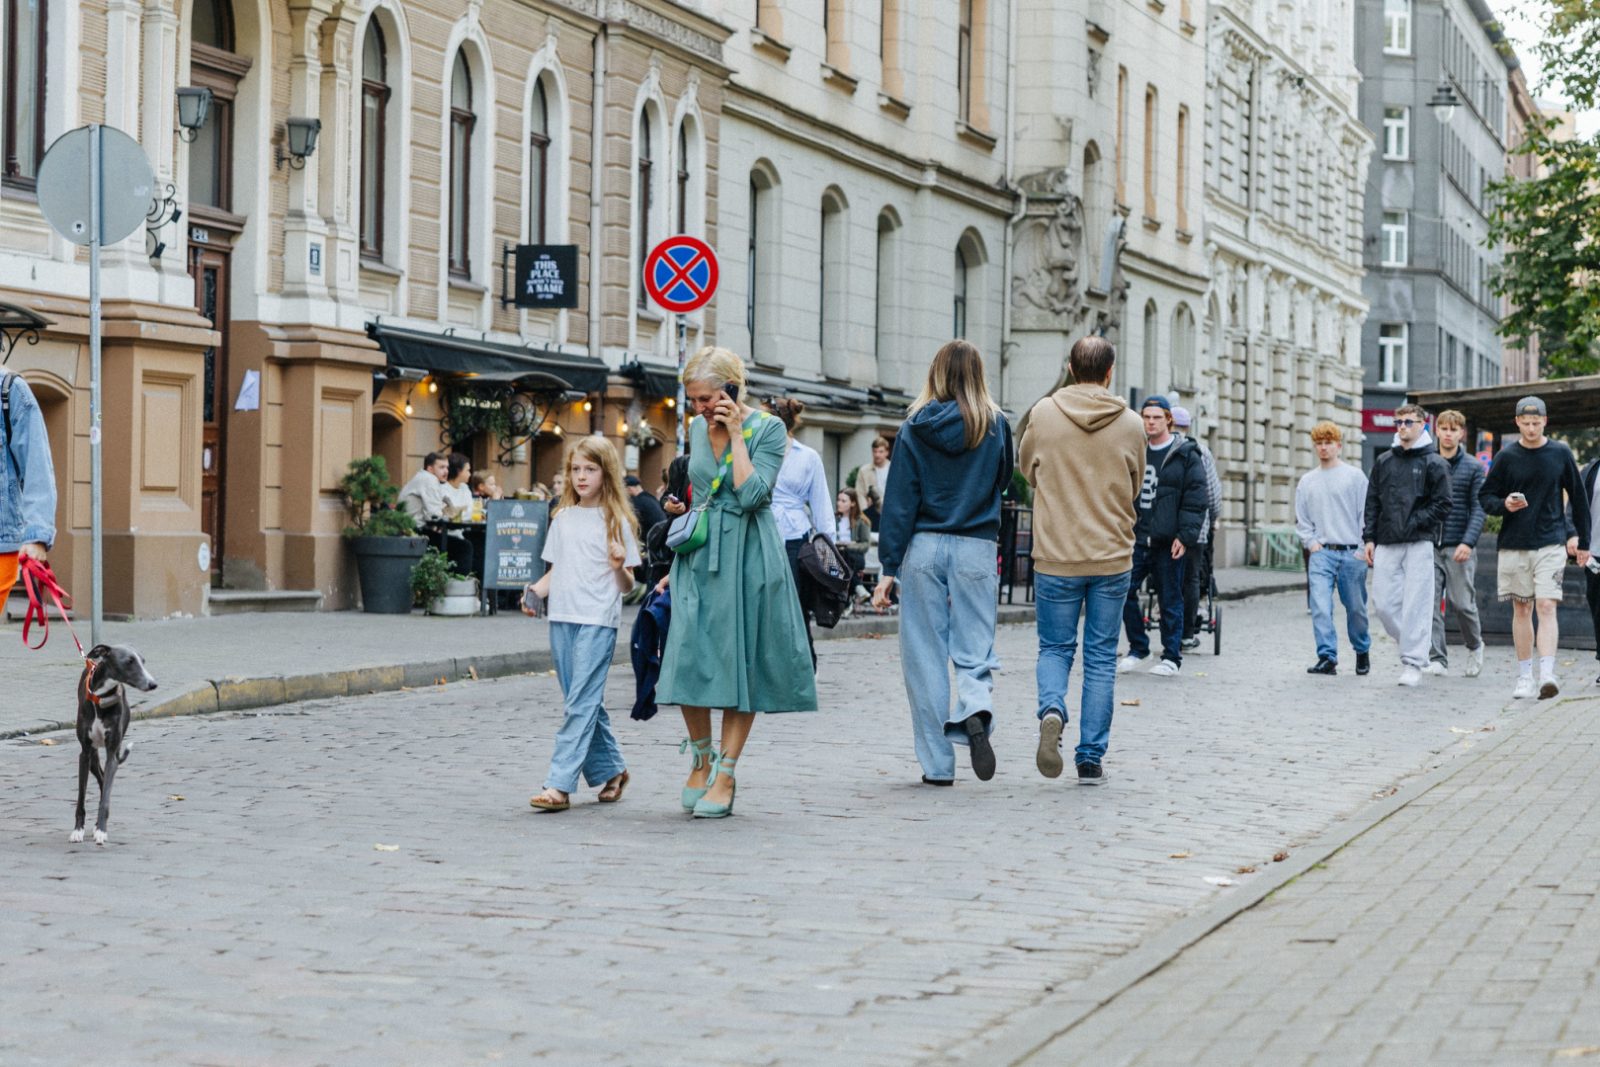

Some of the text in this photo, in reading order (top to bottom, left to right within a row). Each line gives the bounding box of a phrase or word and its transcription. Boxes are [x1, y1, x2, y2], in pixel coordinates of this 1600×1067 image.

[534, 261, 557, 270] THIS
[530, 269, 560, 279] PLACE
[527, 284, 563, 295] A NAME
